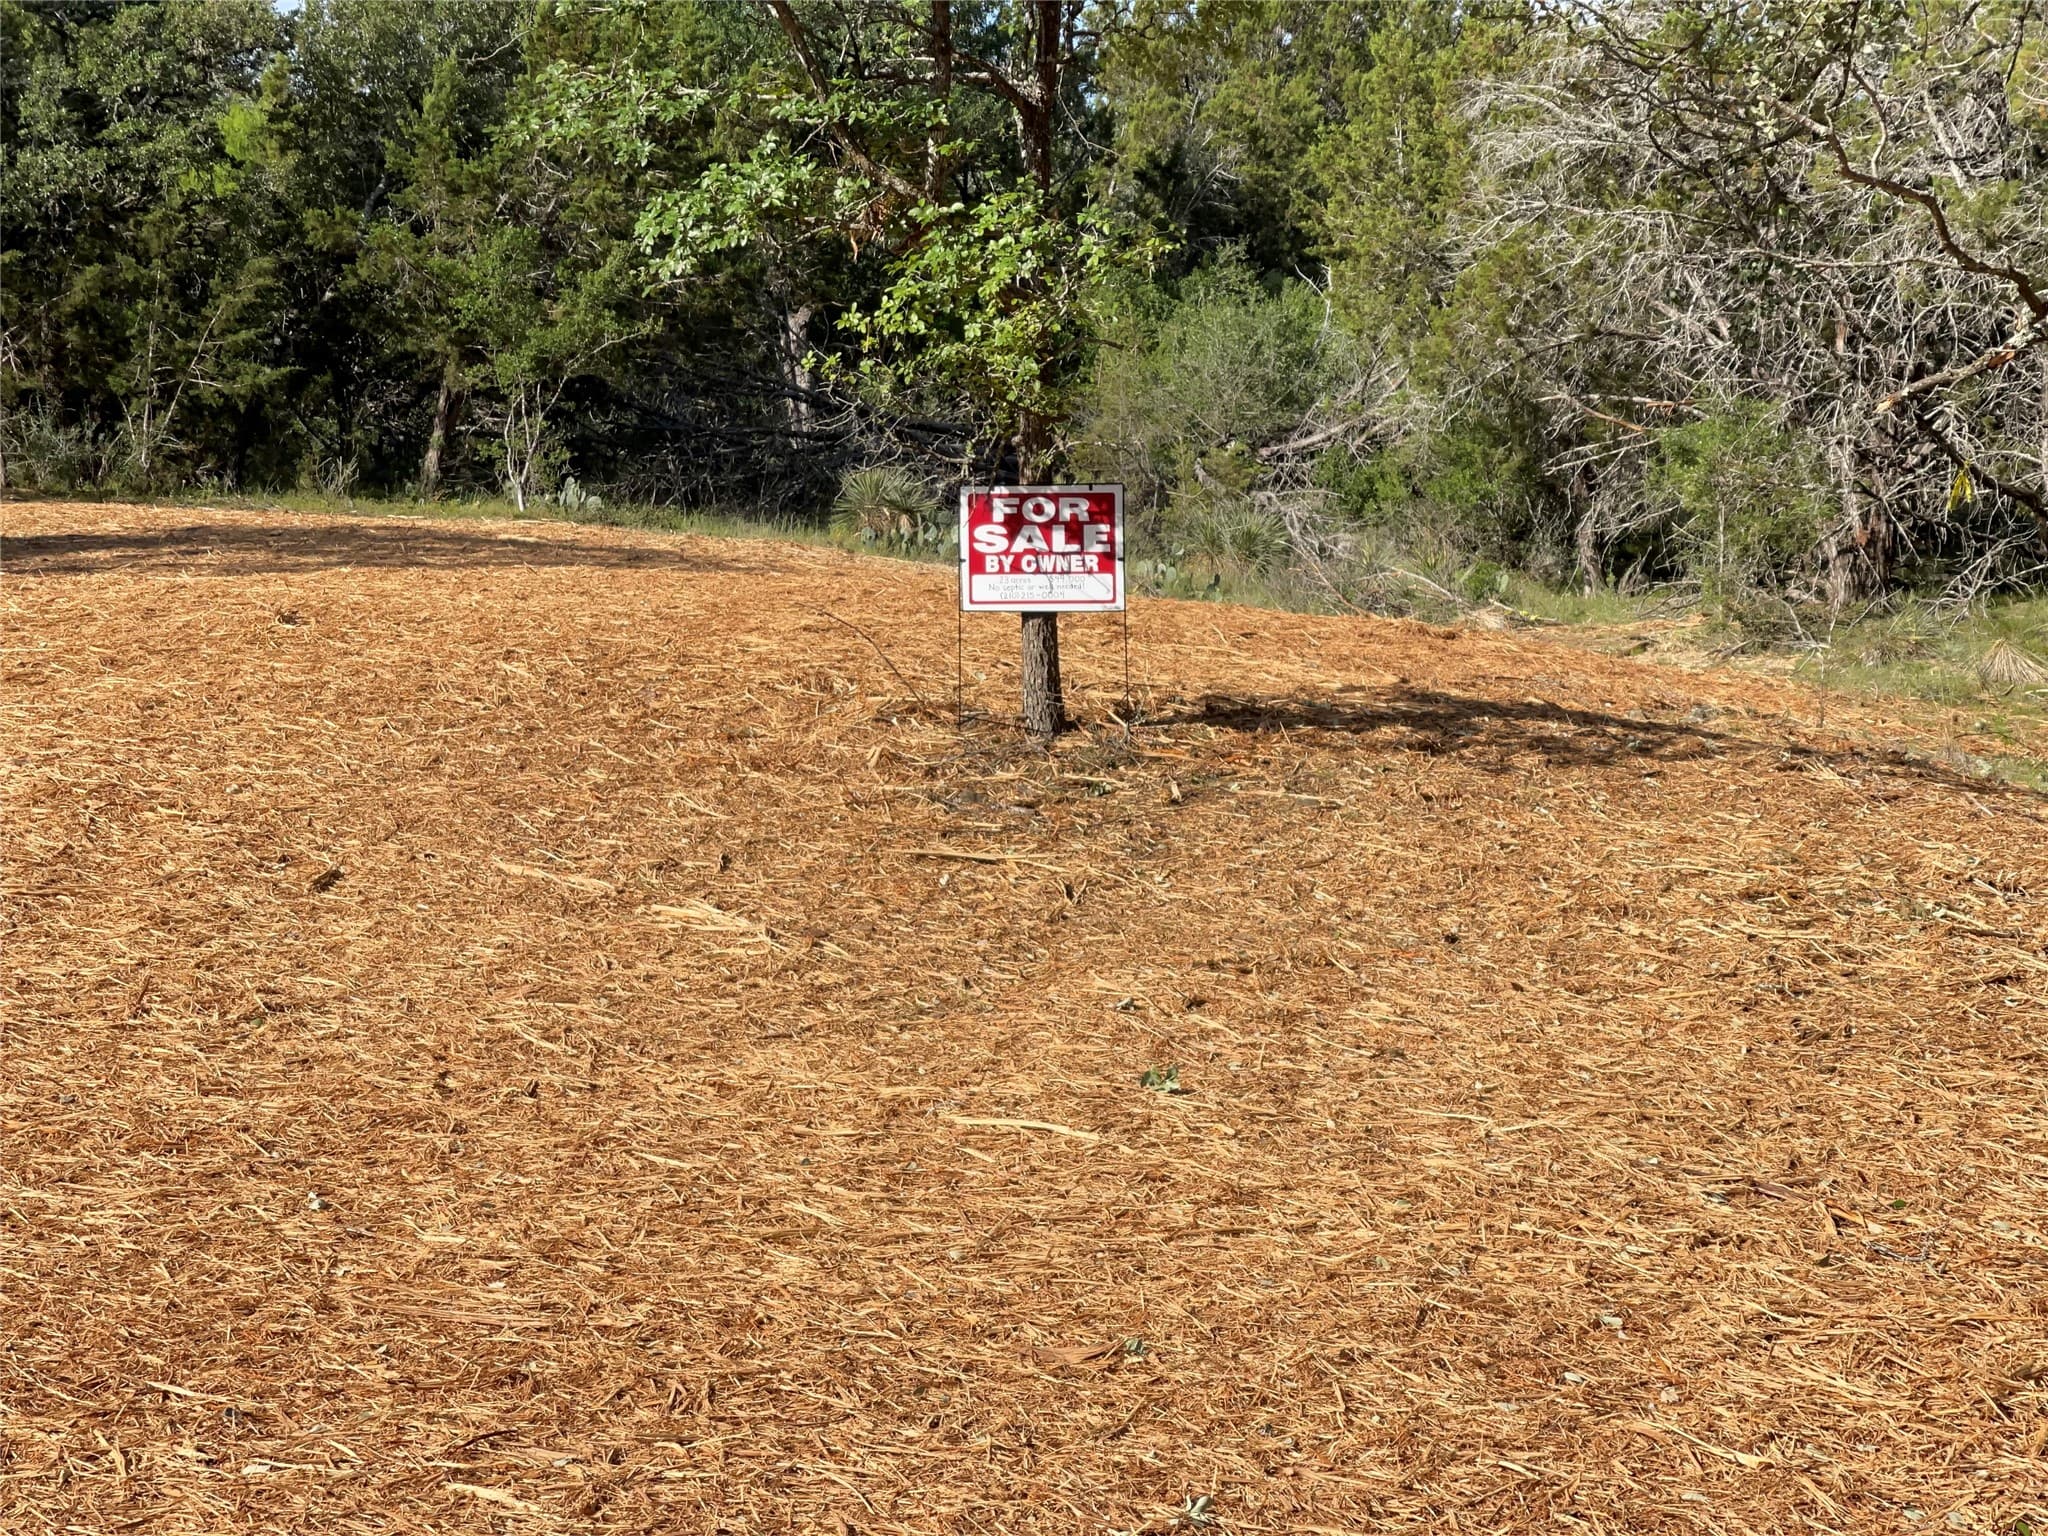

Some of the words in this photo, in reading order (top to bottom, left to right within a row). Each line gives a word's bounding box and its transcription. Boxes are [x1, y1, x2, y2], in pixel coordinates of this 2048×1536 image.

[992, 496, 1090, 523] FOR
[972, 524, 1111, 553] SALE
[985, 554, 1015, 572] BY
[1020, 554, 1099, 572] OWNER
[989, 583, 1000, 591] No
